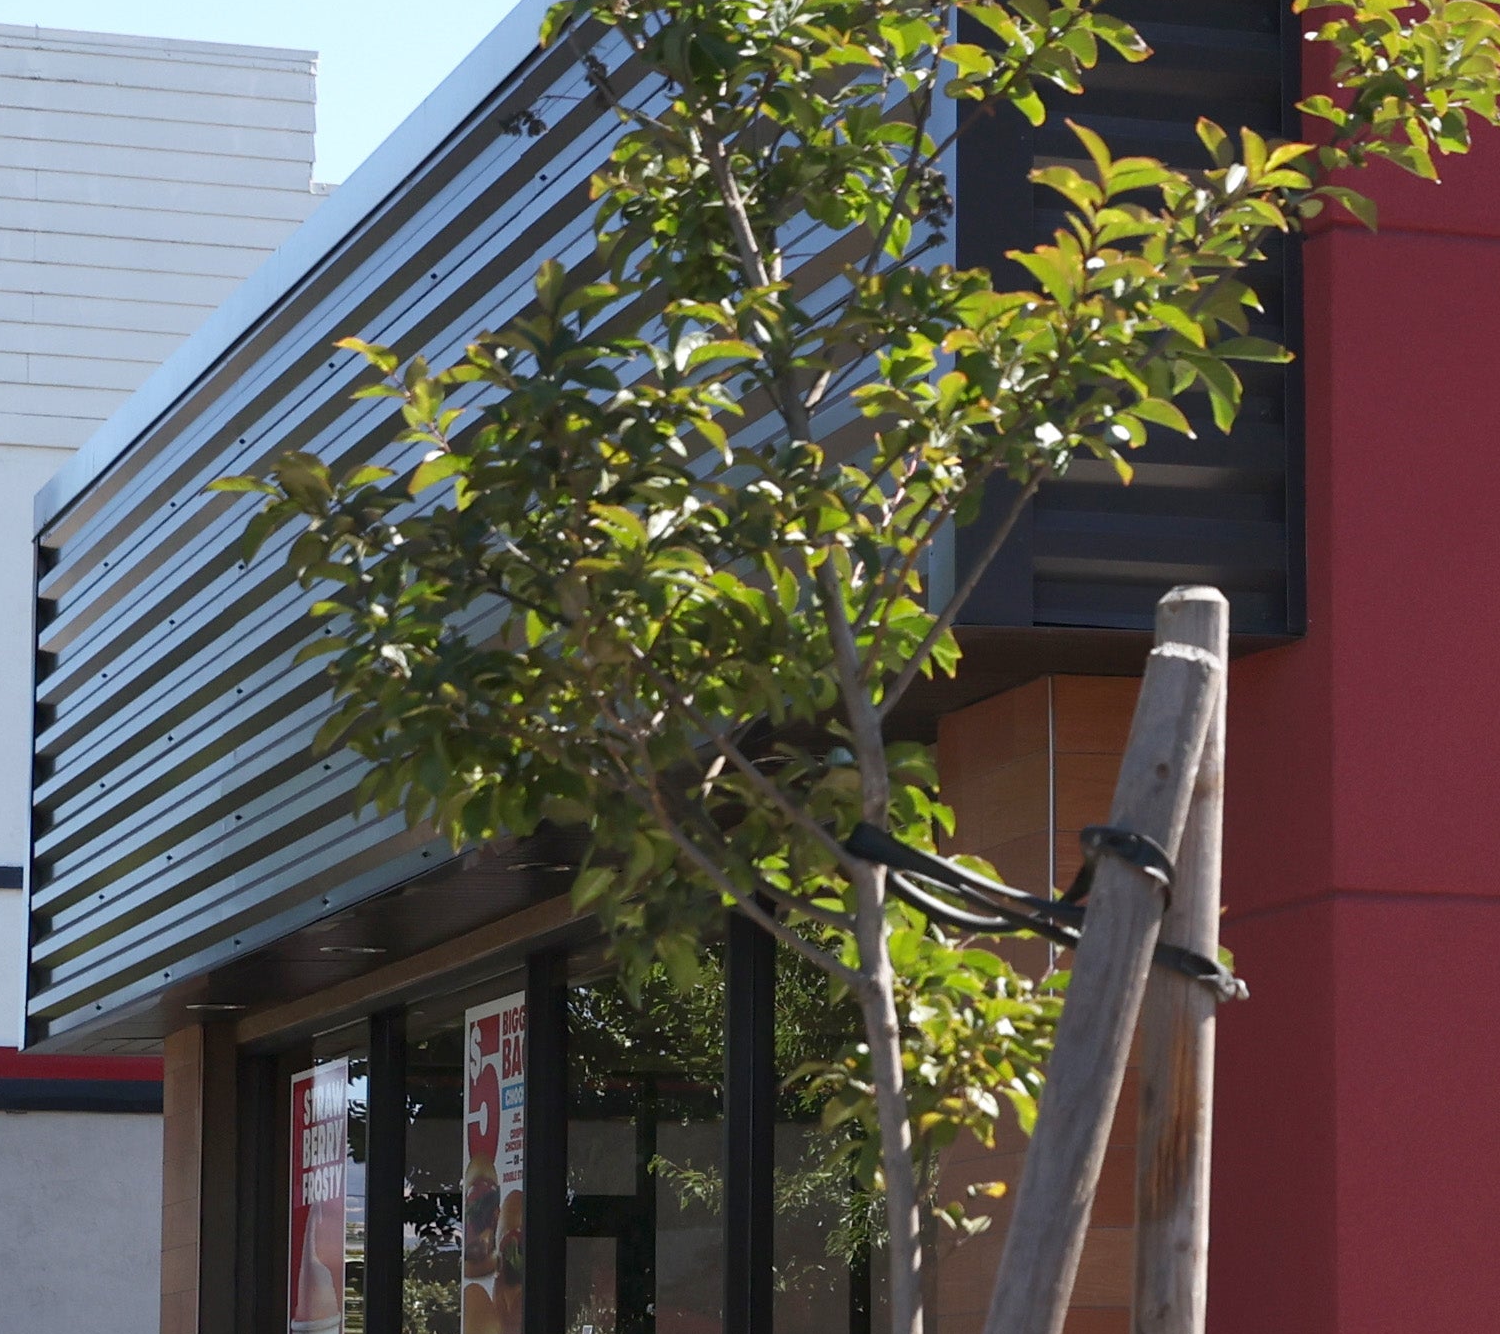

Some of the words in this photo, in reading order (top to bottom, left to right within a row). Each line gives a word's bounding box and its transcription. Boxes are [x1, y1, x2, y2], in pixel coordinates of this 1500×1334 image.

[502, 1005, 527, 1036] BIGG
[502, 1034, 525, 1080] BA
[303, 1079, 345, 1126] STRAW
[302, 1119, 344, 1169] BERRY
[302, 1163, 344, 1206] FROSTY
